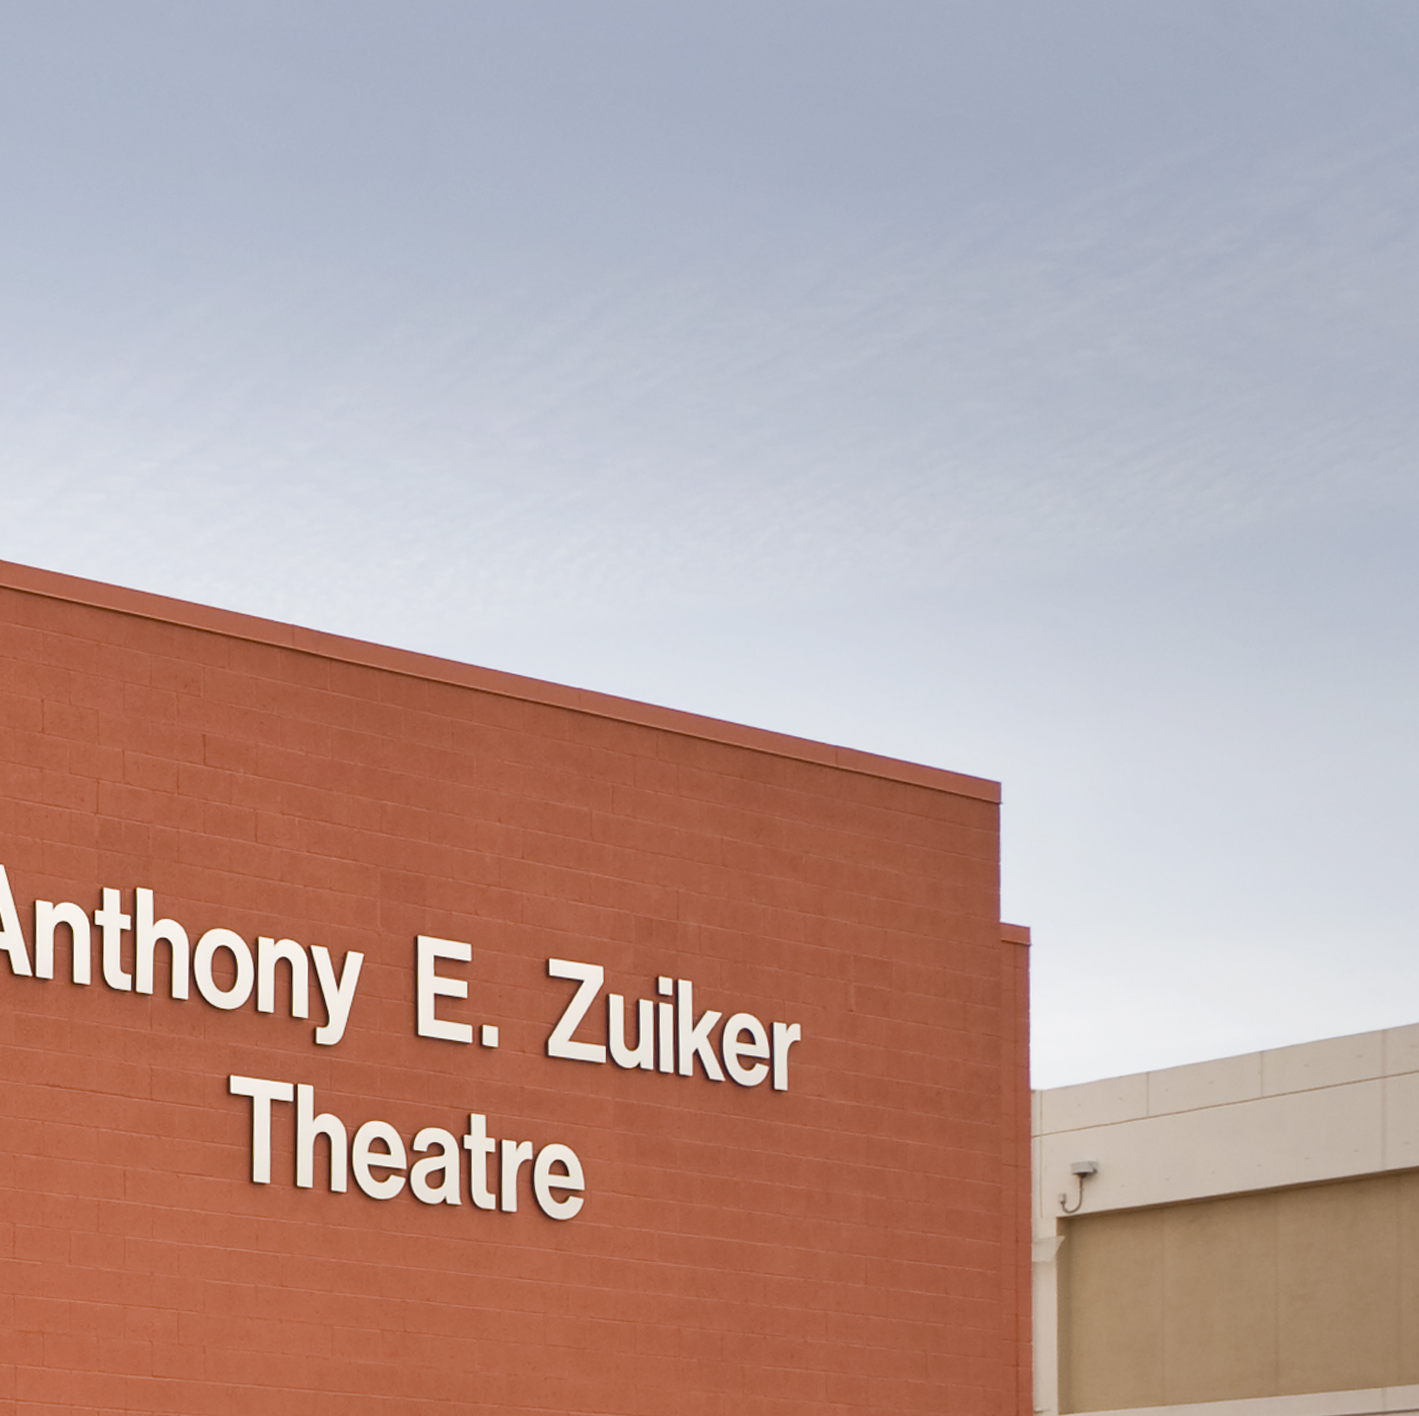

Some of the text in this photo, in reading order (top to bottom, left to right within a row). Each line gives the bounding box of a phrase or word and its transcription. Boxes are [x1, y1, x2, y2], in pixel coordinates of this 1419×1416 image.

[415, 933, 500, 1049] E.
[546, 957, 803, 1092] Zuiker
[228, 1073, 587, 1221] Theatre
